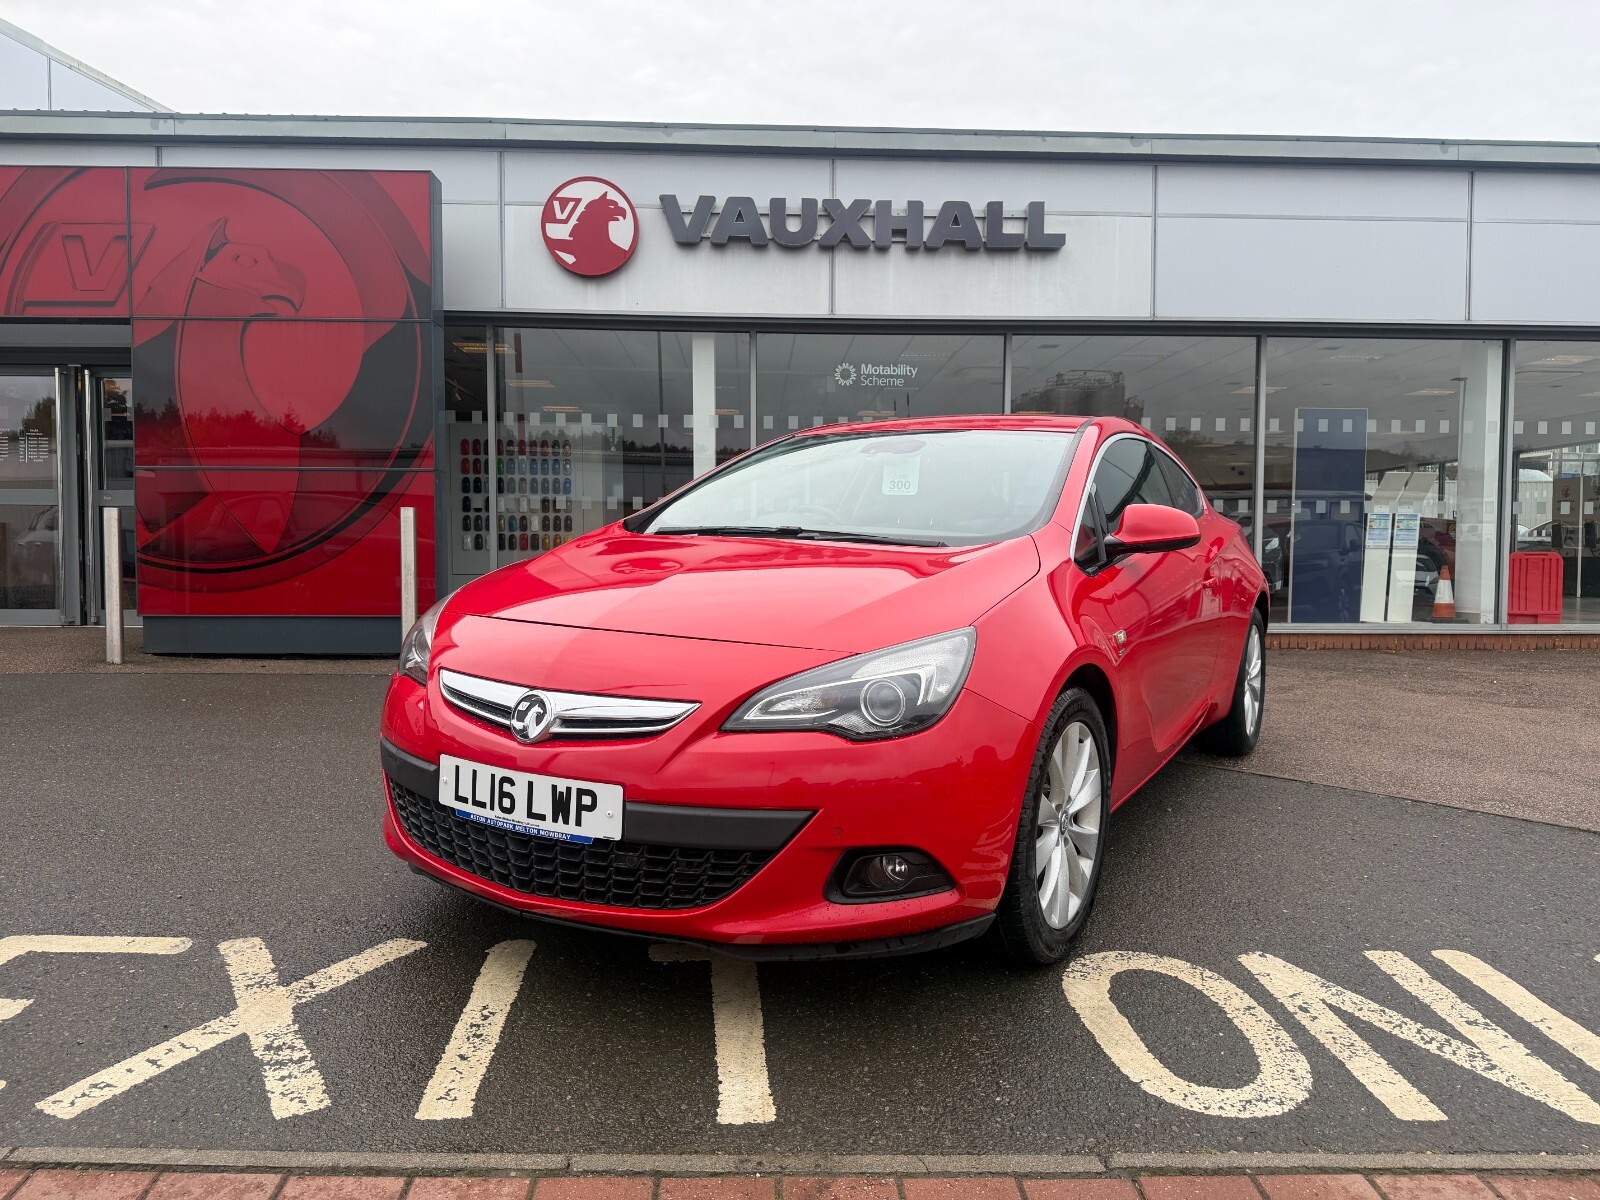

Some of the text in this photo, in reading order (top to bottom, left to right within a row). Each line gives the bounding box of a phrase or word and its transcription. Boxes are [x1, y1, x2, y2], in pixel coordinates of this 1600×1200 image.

[658, 193, 1067, 251] VAUXHALL
[860, 375, 904, 387] Scheme
[861, 363, 918, 378] Motability
[889, 480, 911, 490] 300
[454, 764, 598, 827] LL16 LWP
[470, 813, 486, 823] ASTON
[487, 818, 514, 830] AUTOPARK
[515, 824, 538, 835] MELTON
[539, 830, 571, 840] MOWBRAY
[1062, 950, 1600, 1125] ON
